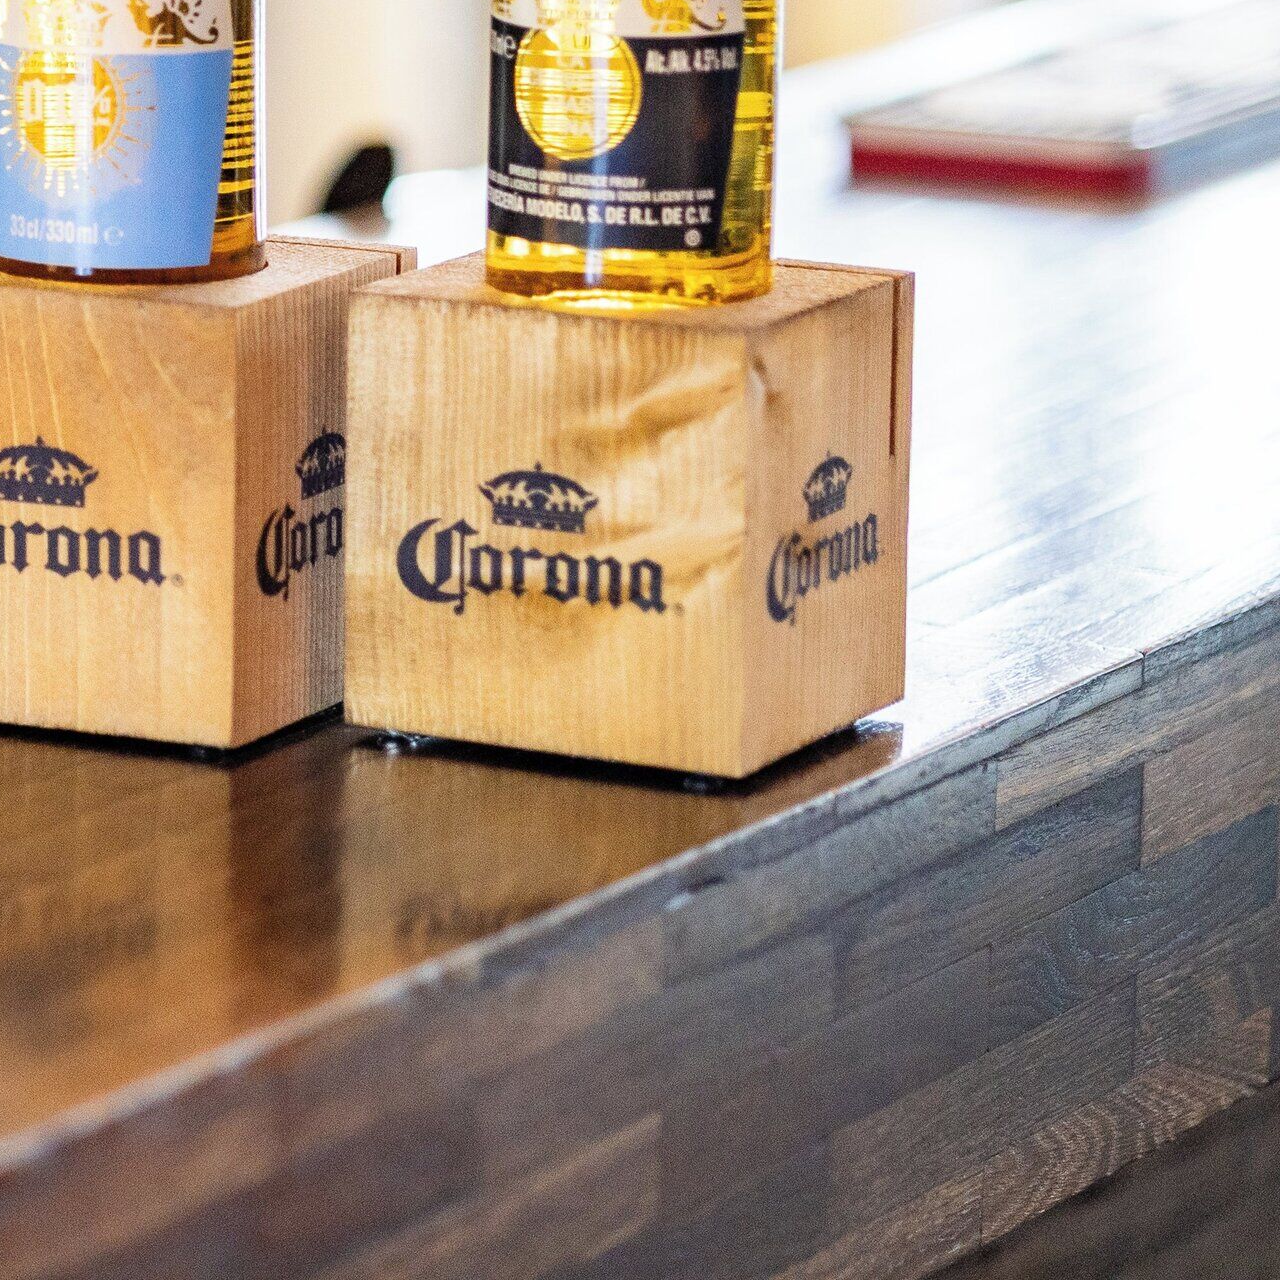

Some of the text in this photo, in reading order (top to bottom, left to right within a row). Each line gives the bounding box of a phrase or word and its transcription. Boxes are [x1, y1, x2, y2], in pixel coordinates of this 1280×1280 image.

[605, 205, 627, 224] DE
[661, 206, 683, 225] DE
[256, 503, 343, 601] Coro
[396, 517, 667, 615] Corona
[765, 512, 878, 626] Corona
